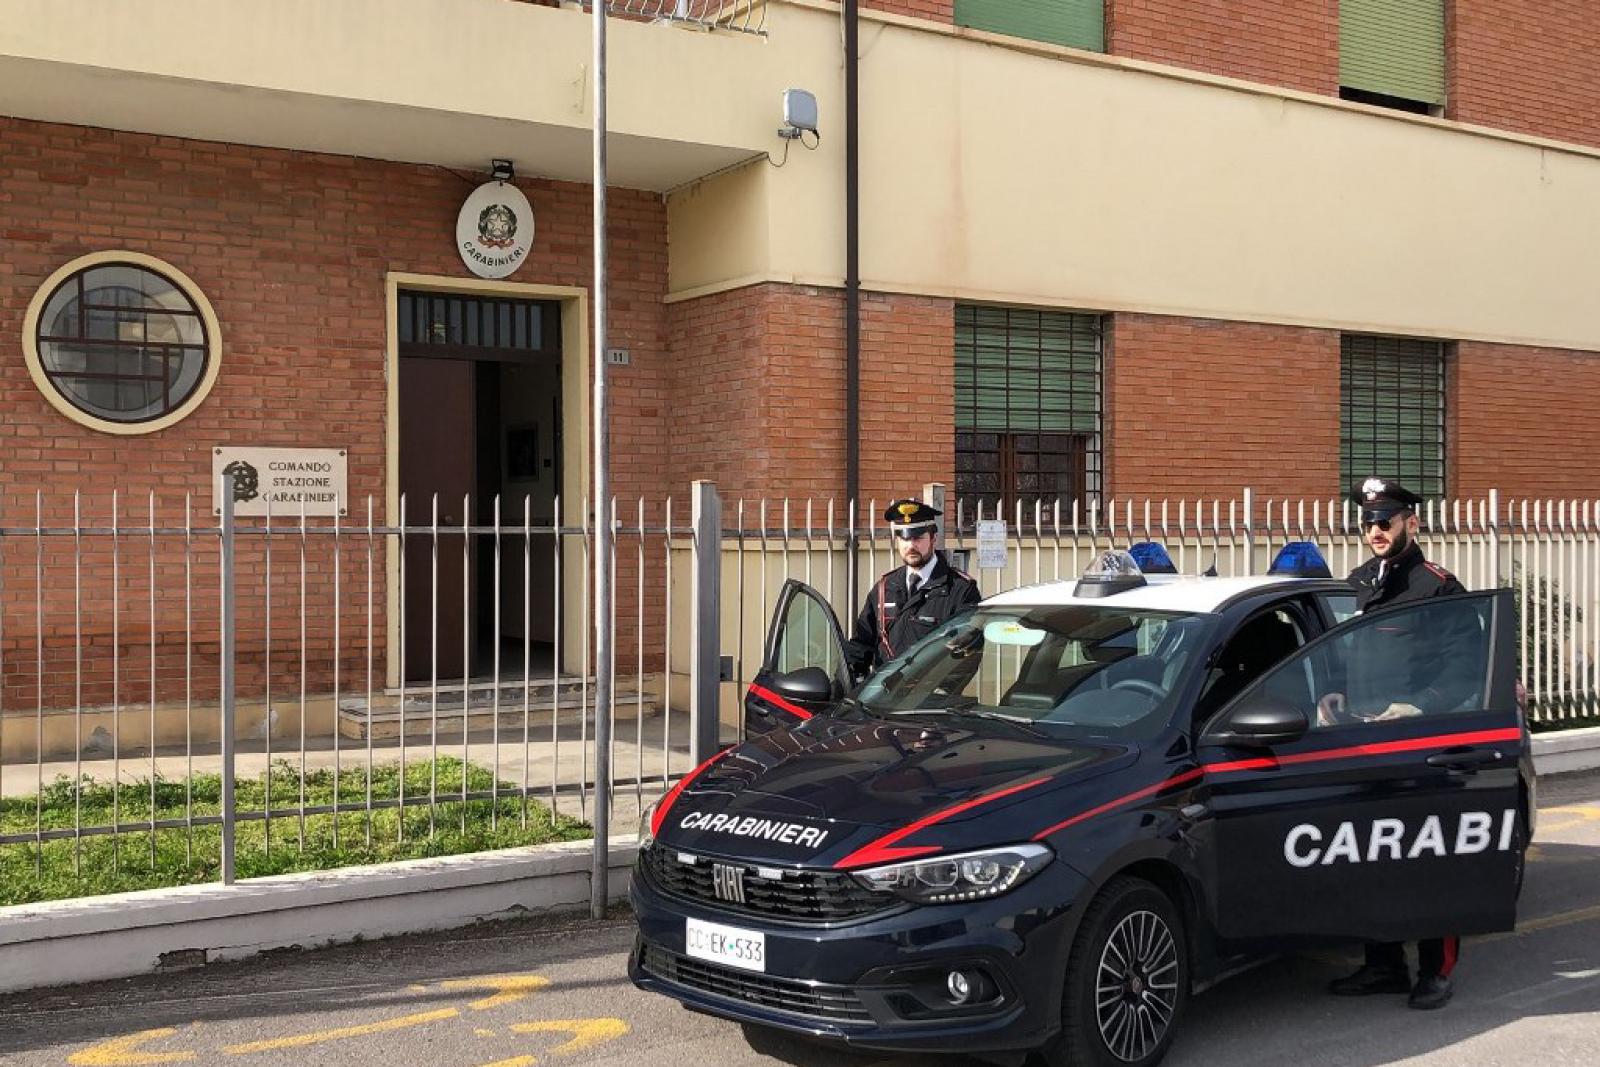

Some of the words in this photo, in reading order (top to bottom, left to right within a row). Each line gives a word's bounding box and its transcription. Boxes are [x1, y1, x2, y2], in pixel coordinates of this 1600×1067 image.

[463, 241, 524, 267] CARABINIERI
[268, 461, 332, 473] COMANDO
[272, 477, 331, 488] STAZIONE
[262, 492, 338, 503] CARABINIER
[680, 811, 829, 848] CARABINIERI
[1283, 808, 1516, 868] CARABI
[713, 863, 746, 904] FIAT
[735, 937, 763, 962] 533
